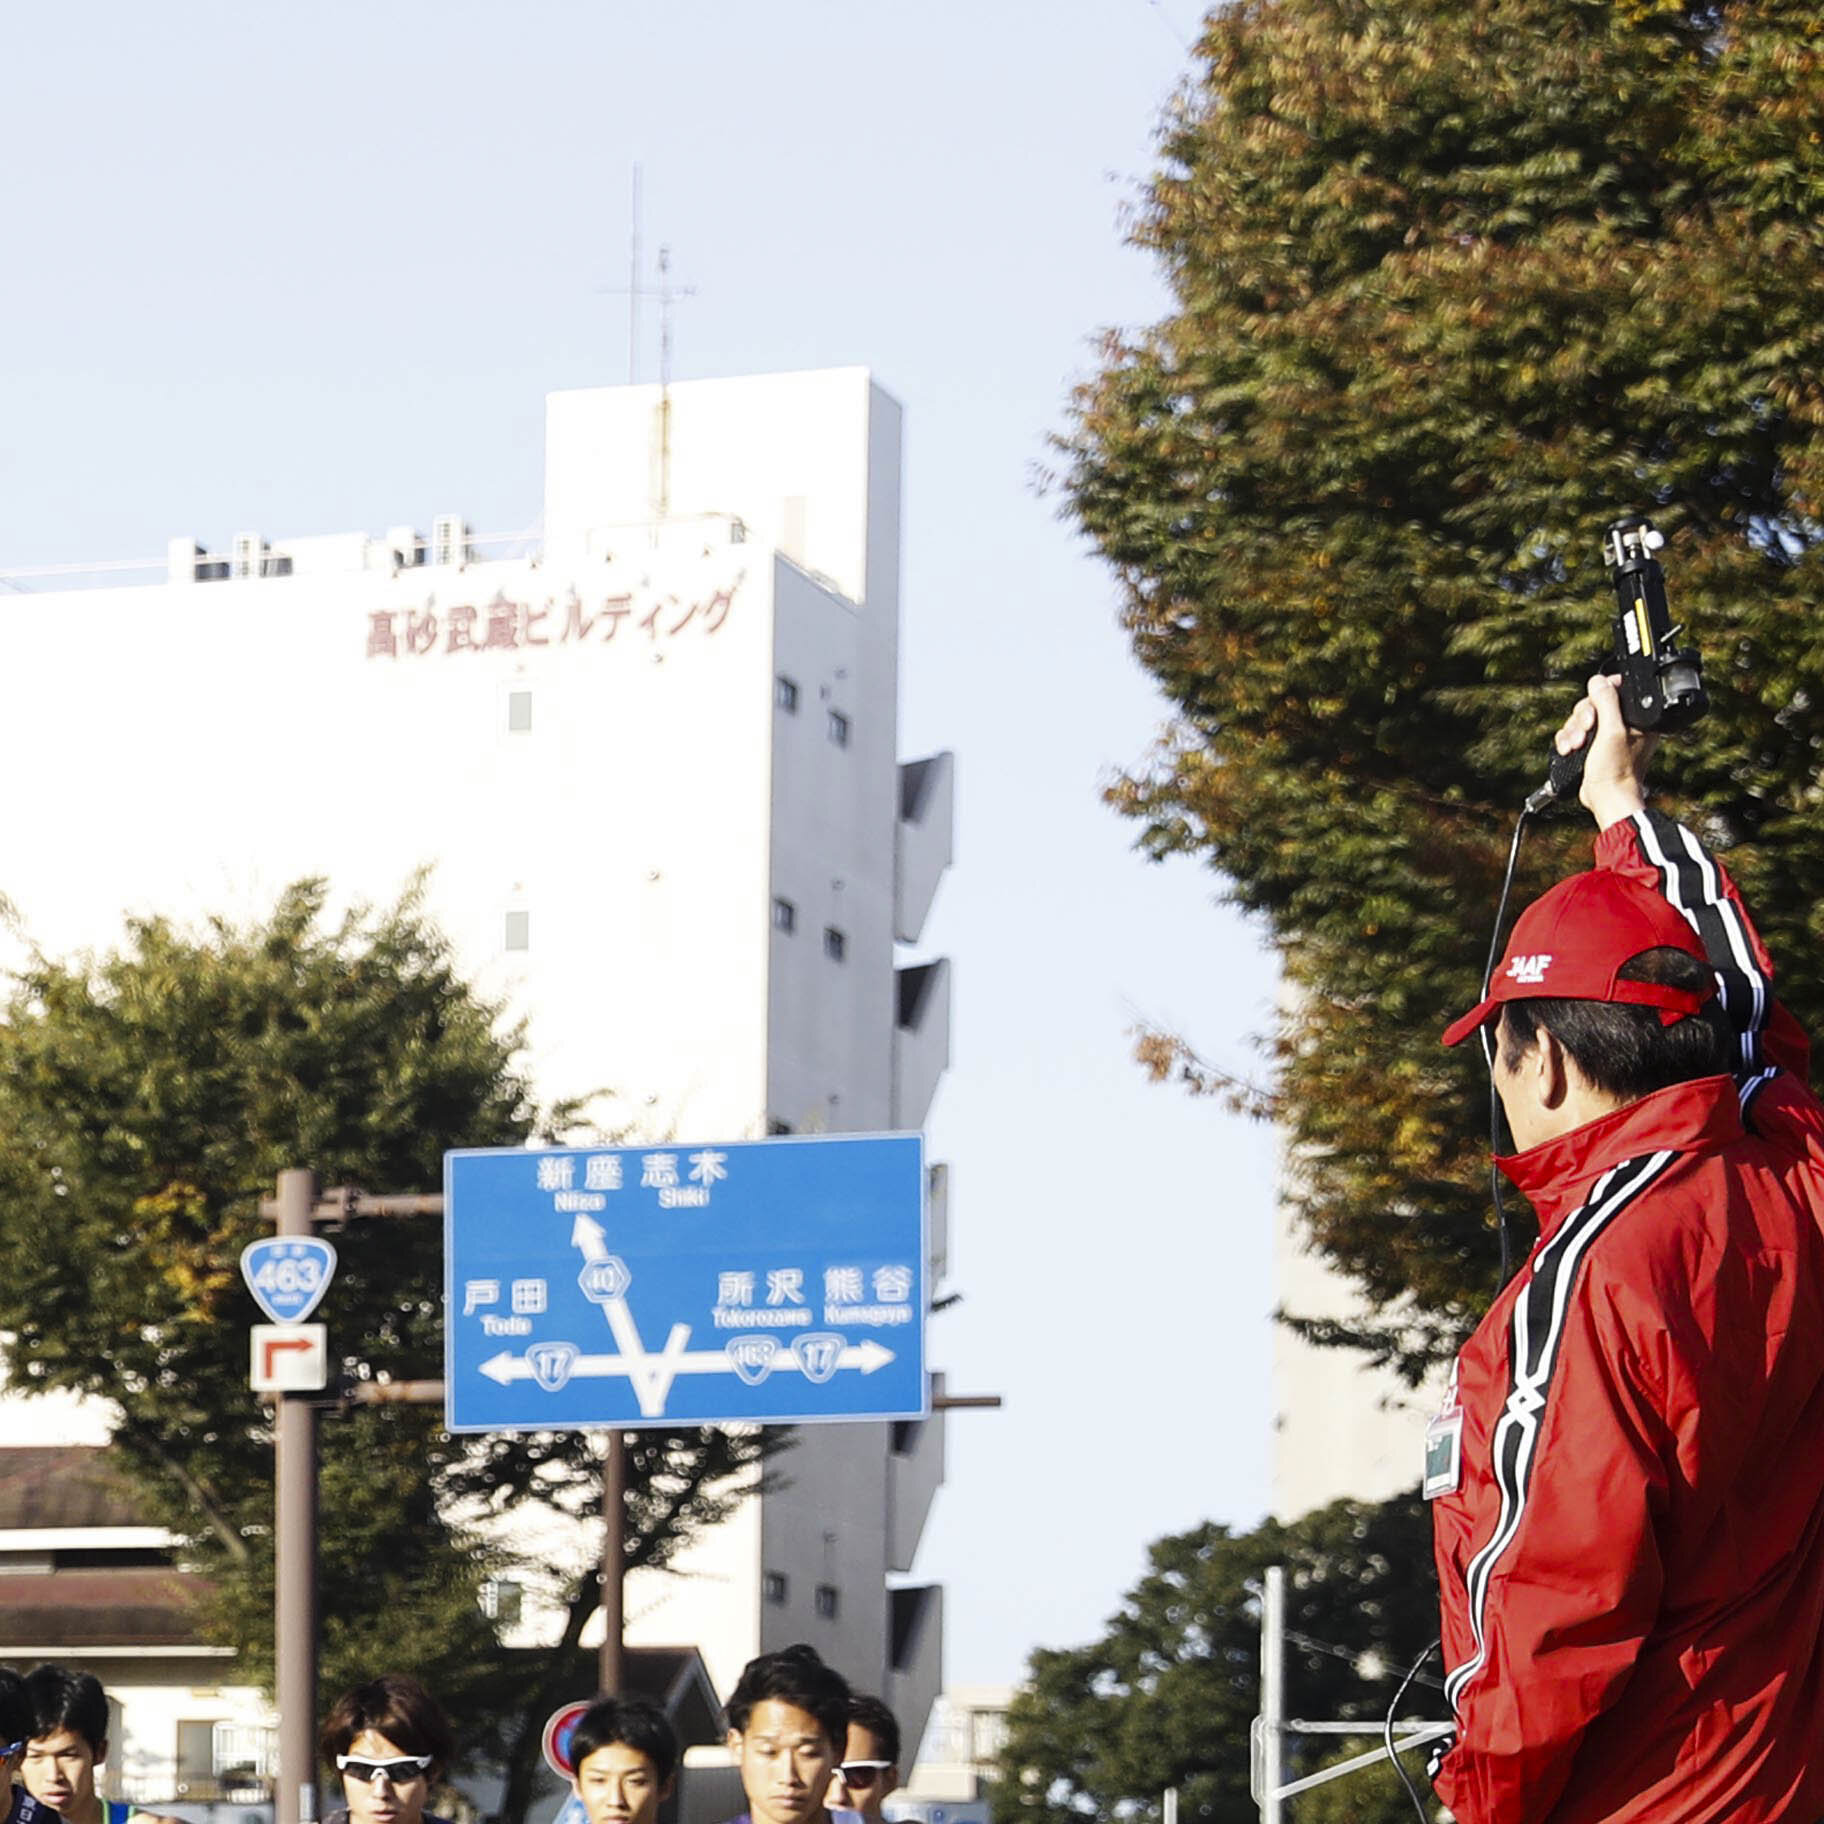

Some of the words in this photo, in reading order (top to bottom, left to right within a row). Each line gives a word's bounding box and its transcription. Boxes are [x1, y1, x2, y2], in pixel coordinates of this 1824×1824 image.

[366, 586, 737, 659] 高砂武蔵ビルディング
[1506, 955, 1552, 976] JAAF
[536, 1155, 623, 1190] 新座
[640, 1149, 728, 1188] 志木
[658, 1187, 710, 1209] Shiki
[255, 1257, 322, 1293] 463
[717, 1269, 805, 1306] 所沢
[824, 1265, 913, 1303] 熊谷
[464, 1279, 548, 1316] 戸田
[538, 1351, 567, 1377] 17
[806, 1341, 834, 1368] 17
